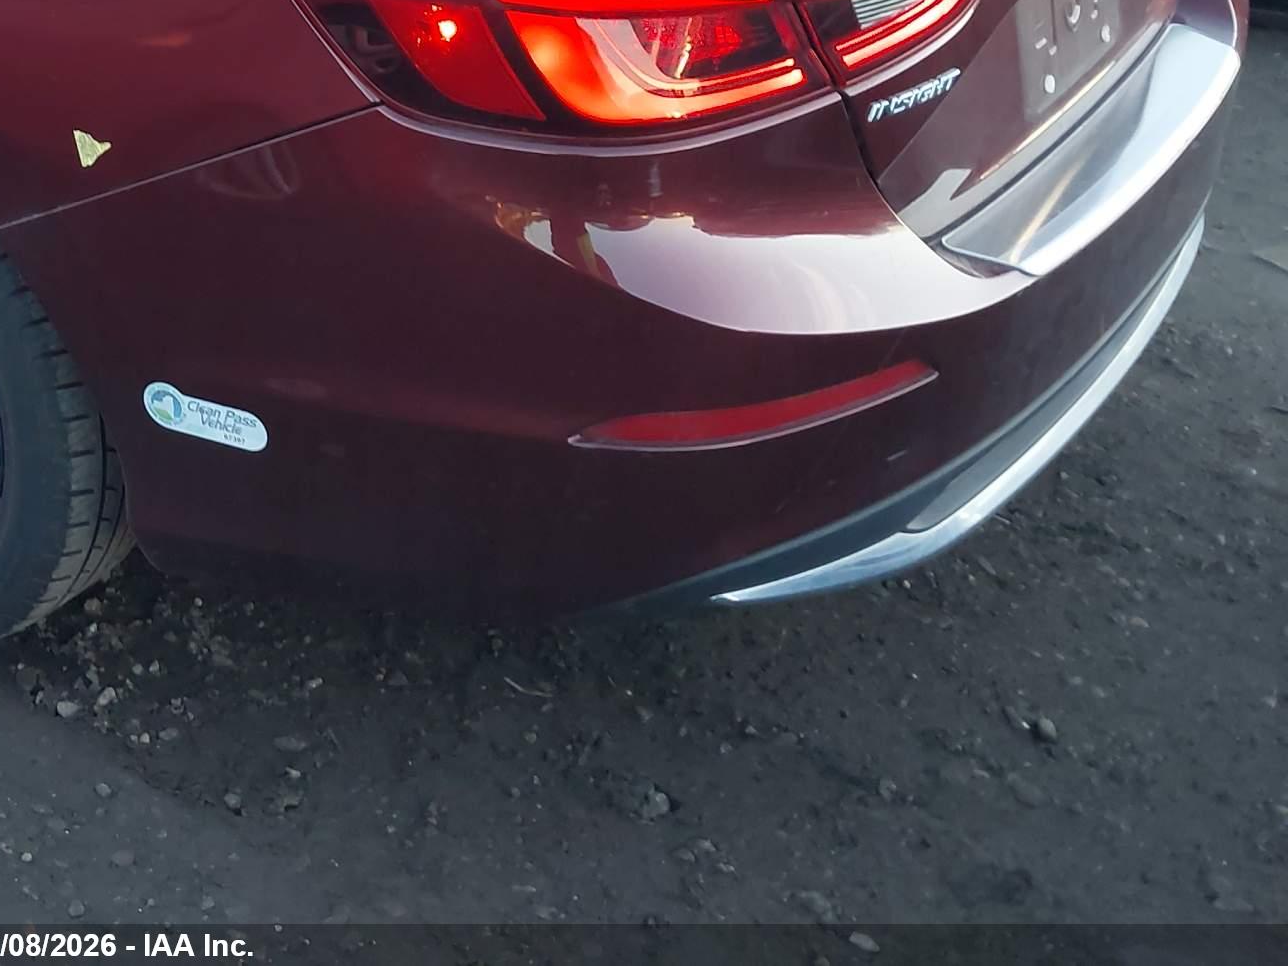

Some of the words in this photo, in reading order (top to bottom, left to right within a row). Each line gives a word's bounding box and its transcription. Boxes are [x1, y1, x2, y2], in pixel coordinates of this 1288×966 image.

[867, 67, 961, 122] INSIGHT
[187, 400, 222, 418] Clean
[226, 410, 258, 428] Pass
[199, 414, 243, 435] Vehicle
